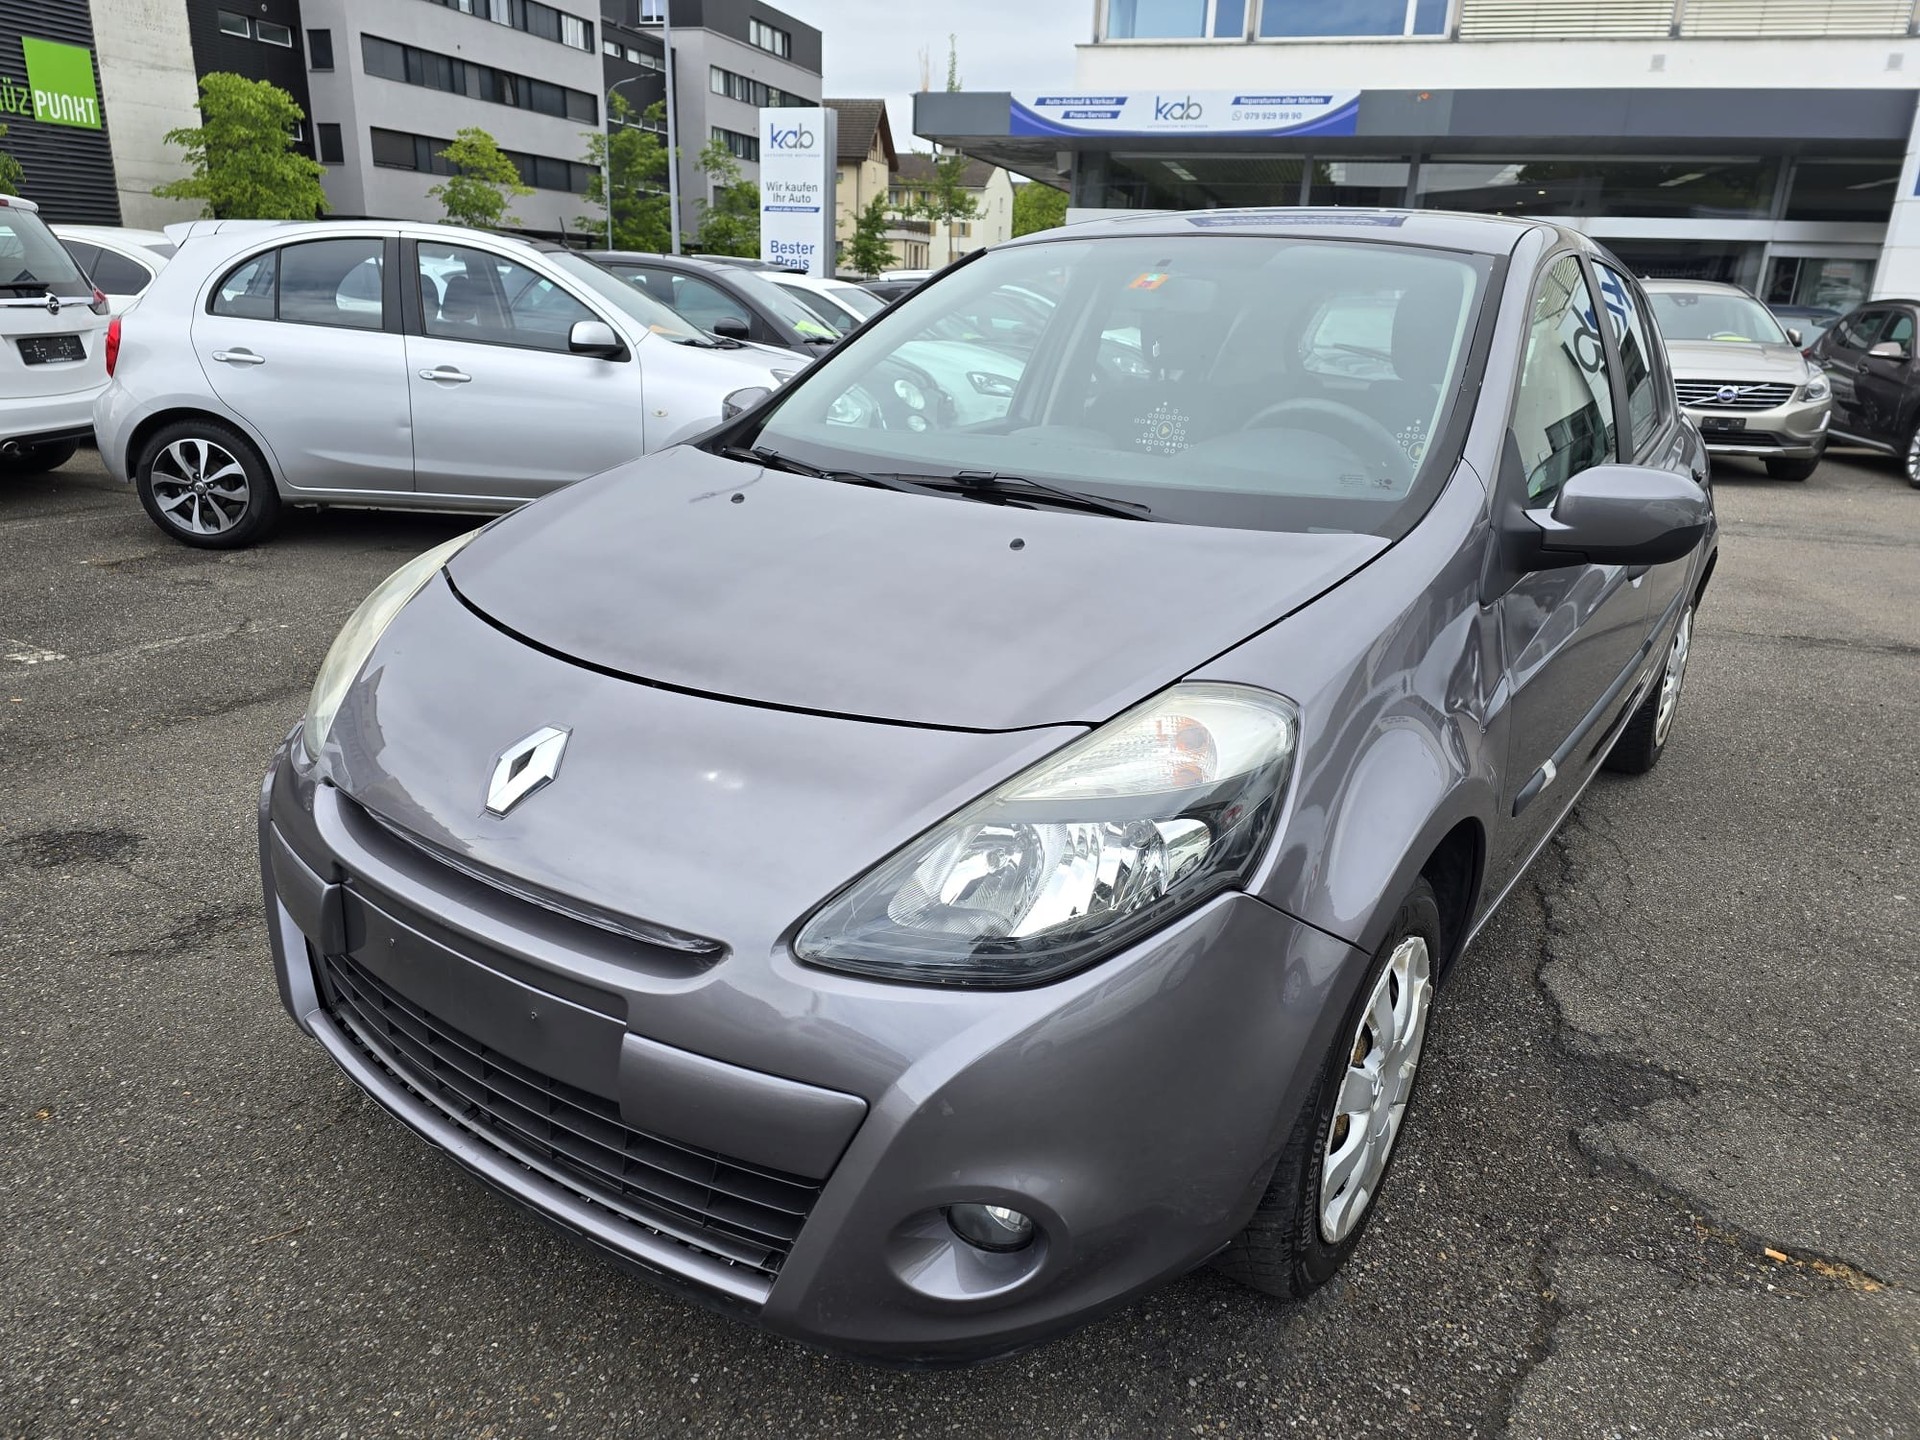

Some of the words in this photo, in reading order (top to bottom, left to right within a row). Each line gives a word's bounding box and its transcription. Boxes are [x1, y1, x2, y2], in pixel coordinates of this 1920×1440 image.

[0, 76, 31, 115] ÜZ
[1155, 95, 1202, 120] kab
[1244, 112, 1260, 120] 079
[1261, 112, 1277, 120] 929
[770, 122, 814, 149] kab
[766, 181, 782, 191] Wir
[785, 181, 818, 192] kaufen
[772, 193, 786, 203] Ihr
[788, 194, 812, 204] Auto
[770, 240, 815, 255] Bester
